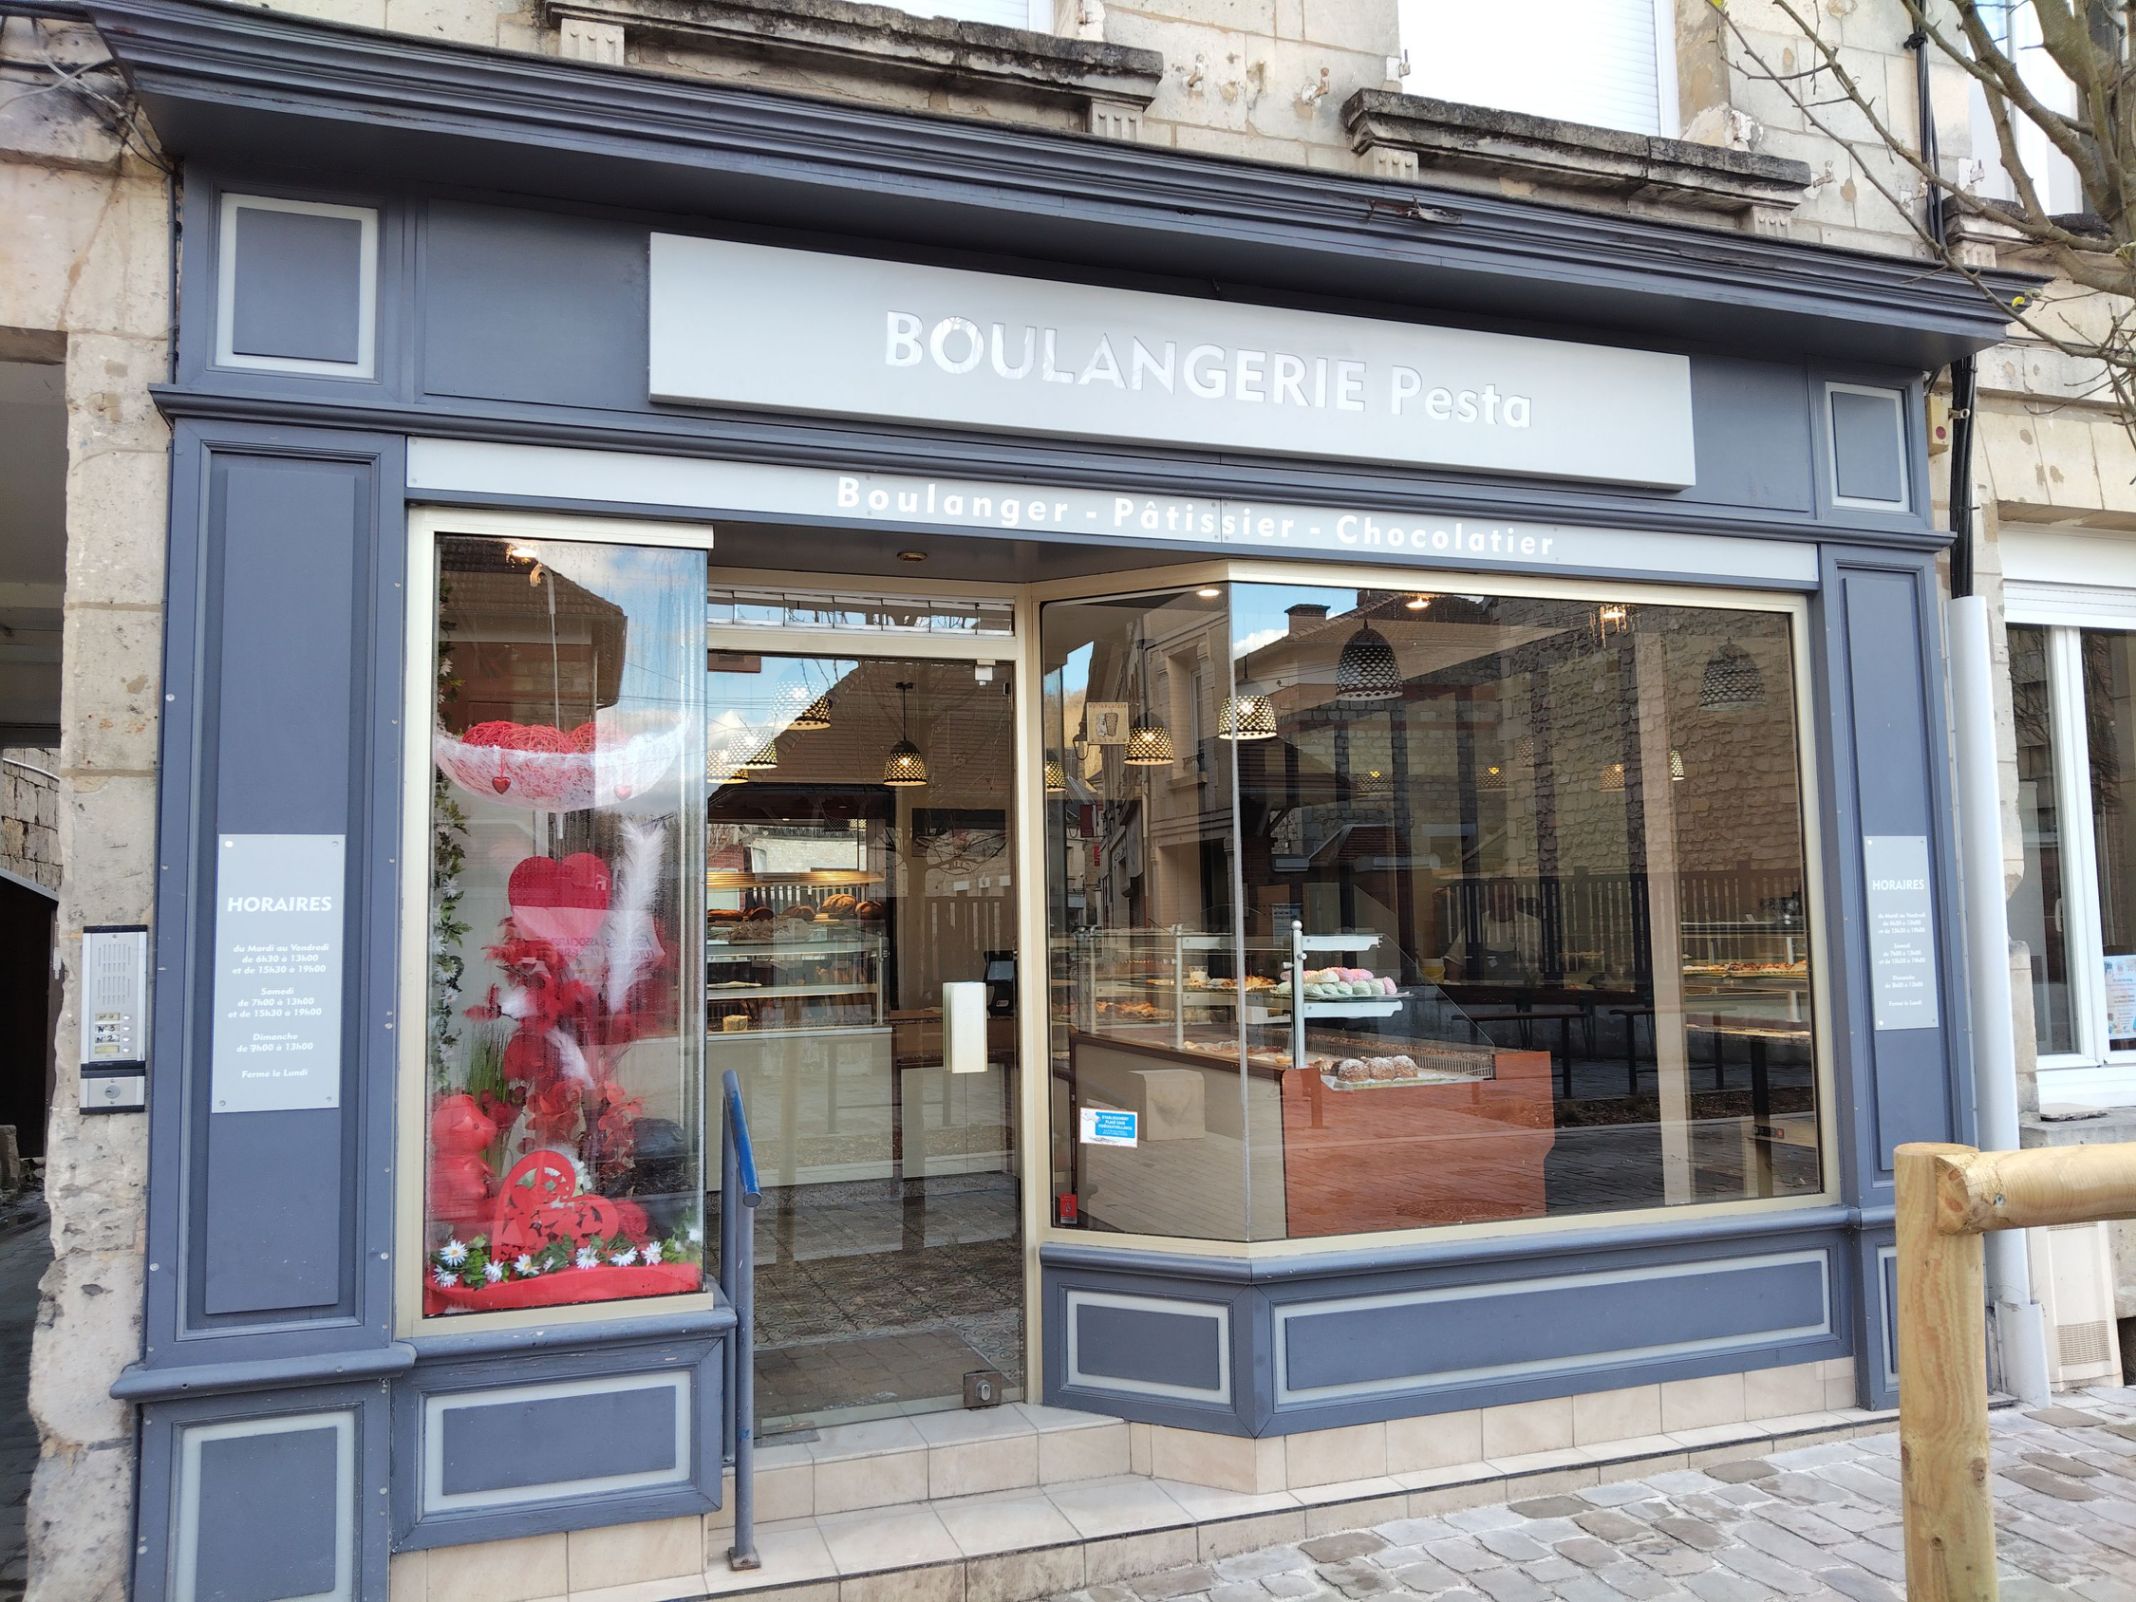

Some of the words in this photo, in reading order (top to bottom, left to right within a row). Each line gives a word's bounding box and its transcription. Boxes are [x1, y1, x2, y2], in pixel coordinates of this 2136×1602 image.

[885, 310, 1367, 413] BOULANGERIE
[1391, 365, 1532, 428] Pesta
[837, 476, 1069, 526] Boulanger
[1113, 497, 1295, 538] Pâtissier
[1336, 514, 1554, 555] Chocolatier
[1872, 879, 1925, 891] HORAIRES
[227, 896, 332, 912] HORAIRES
[233, 944, 246, 952] du
[247, 943, 274, 952] Mardi
[290, 943, 330, 952] Vendredi
[242, 955, 254, 963] de
[290, 954, 319, 963] 13h00
[244, 966, 256, 974] de
[258, 965, 287, 974] 15h30
[298, 964, 327, 973] 19h00
[260, 987, 295, 996] Samedi
[237, 999, 249, 1007] de
[251, 998, 275, 1007] 7h00
[287, 997, 315, 1006] 13h00
[239, 1010, 251, 1018] de
[254, 1009, 282, 1017] 15h30
[294, 1008, 322, 1017] 19h00
[252, 1032, 299, 1041] Dimanche
[236, 1044, 248, 1052] de
[286, 1042, 314, 1051] 13h00
[283, 1067, 309, 1077] Lundi
